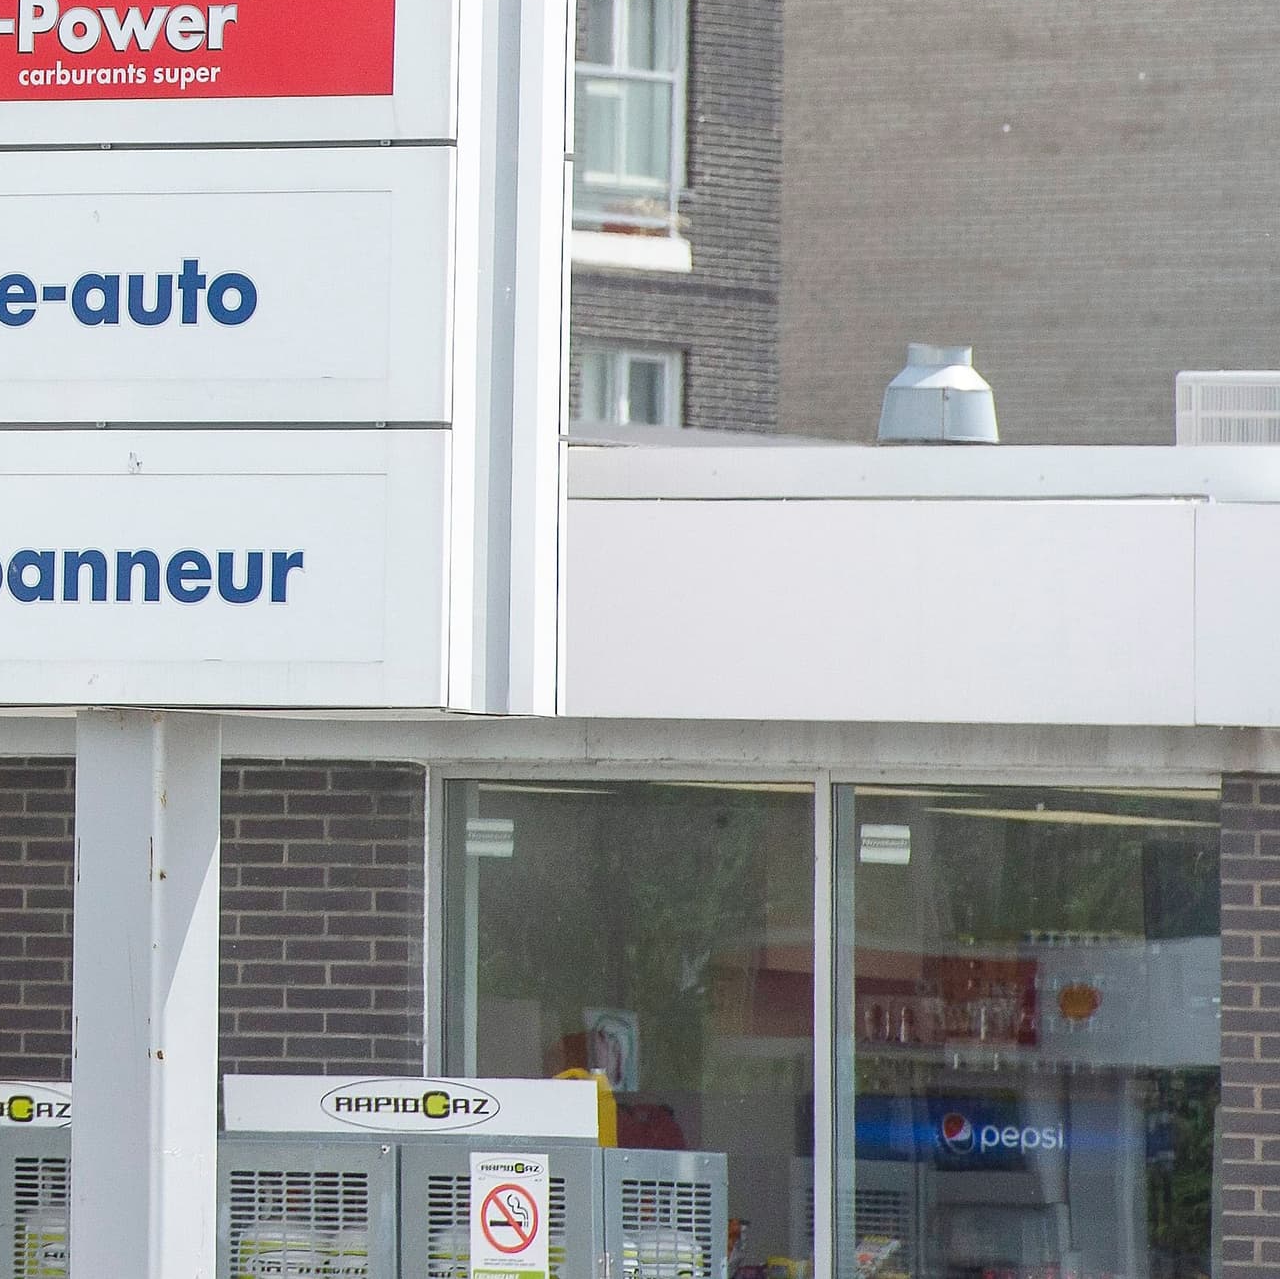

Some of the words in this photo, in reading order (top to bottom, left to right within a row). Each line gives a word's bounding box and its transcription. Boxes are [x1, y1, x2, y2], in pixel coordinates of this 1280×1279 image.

[18, 61, 147, 86] carburants
[153, 65, 221, 90] super
[980, 1124, 1064, 1154] pepsi
